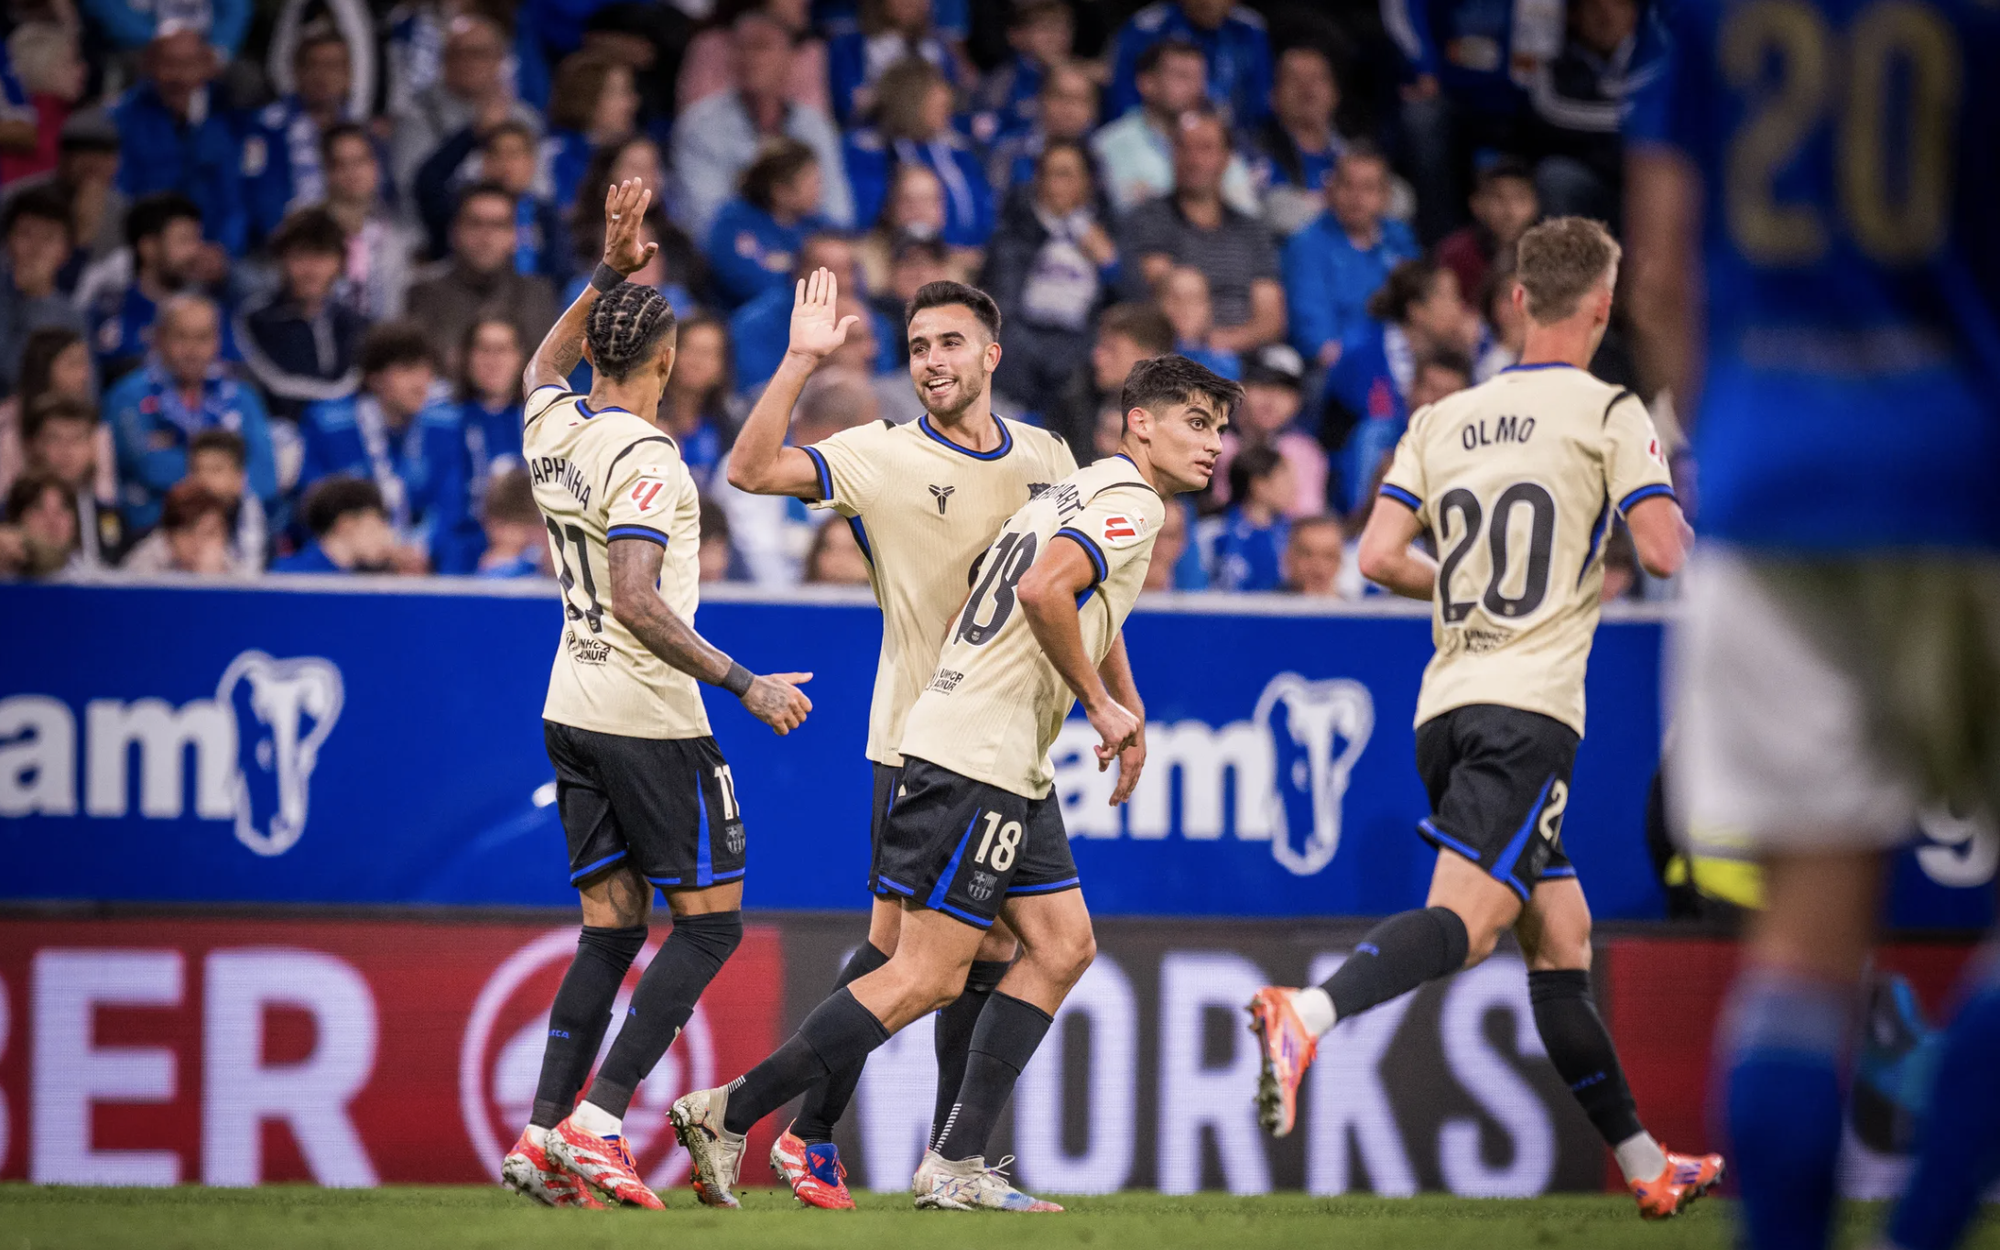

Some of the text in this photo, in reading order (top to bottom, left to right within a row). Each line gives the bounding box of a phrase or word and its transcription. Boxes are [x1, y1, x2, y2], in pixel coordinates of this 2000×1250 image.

[1717, 3, 1962, 267] 20
[1462, 414, 1537, 450] OLMO
[531, 457, 592, 511] APHINHA
[953, 531, 1039, 647] 18
[1438, 482, 1556, 626] 20
[974, 810, 1023, 873] 18
[1538, 778, 1569, 848] 2
[0, 945, 381, 1188] ER
